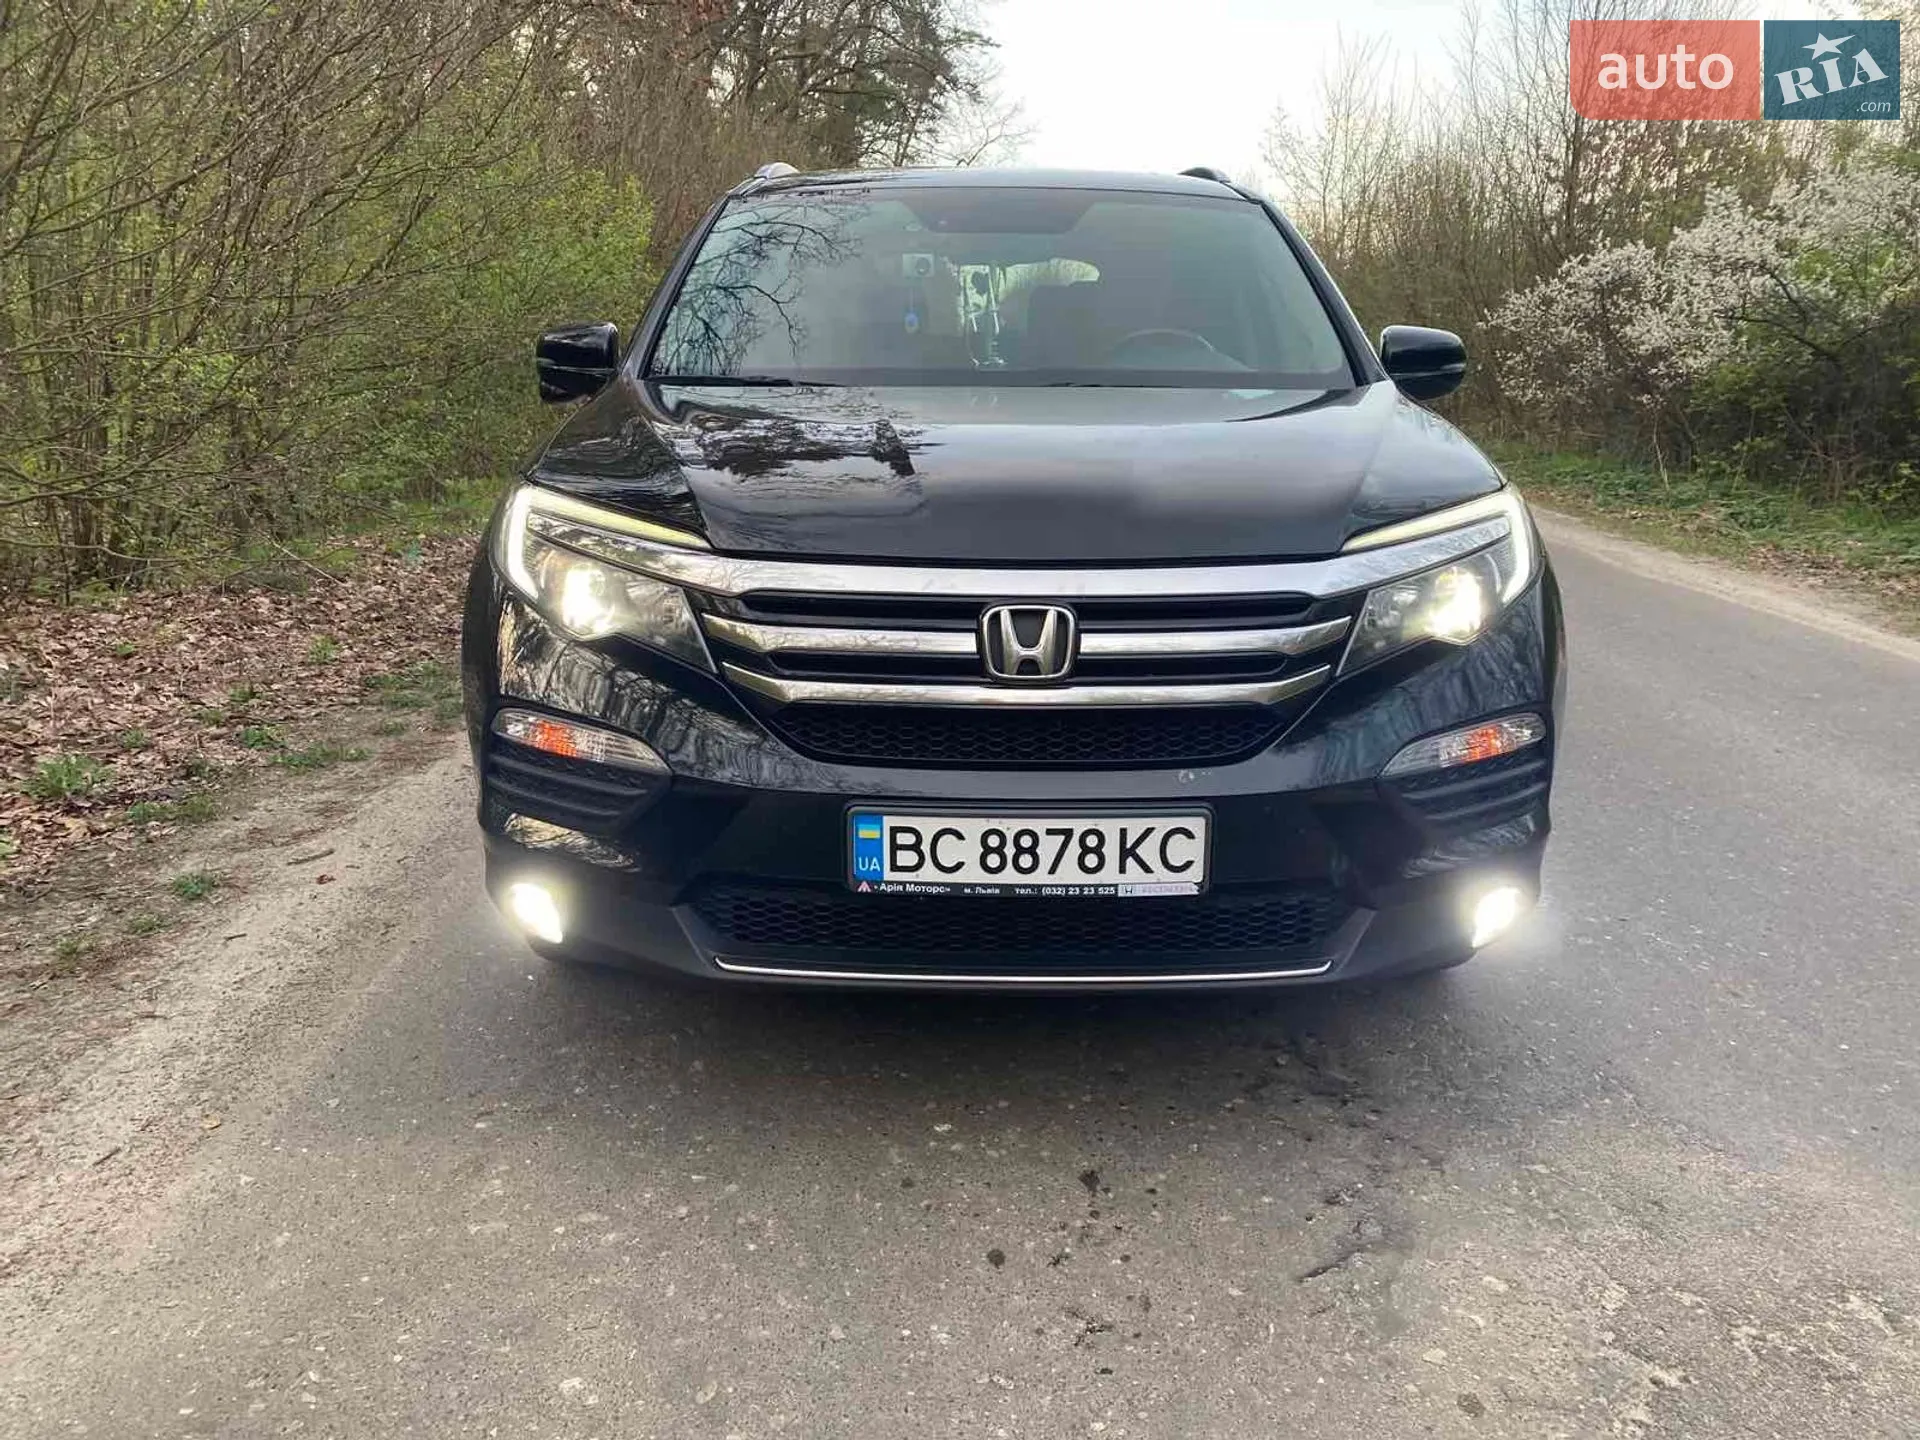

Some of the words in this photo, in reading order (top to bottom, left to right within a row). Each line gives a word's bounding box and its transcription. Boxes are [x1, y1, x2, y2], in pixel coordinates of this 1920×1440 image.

[858, 857, 880, 872] UA
[889, 825, 966, 874] BC
[979, 828, 1106, 875] 8878
[1118, 826, 1196, 875] KC
